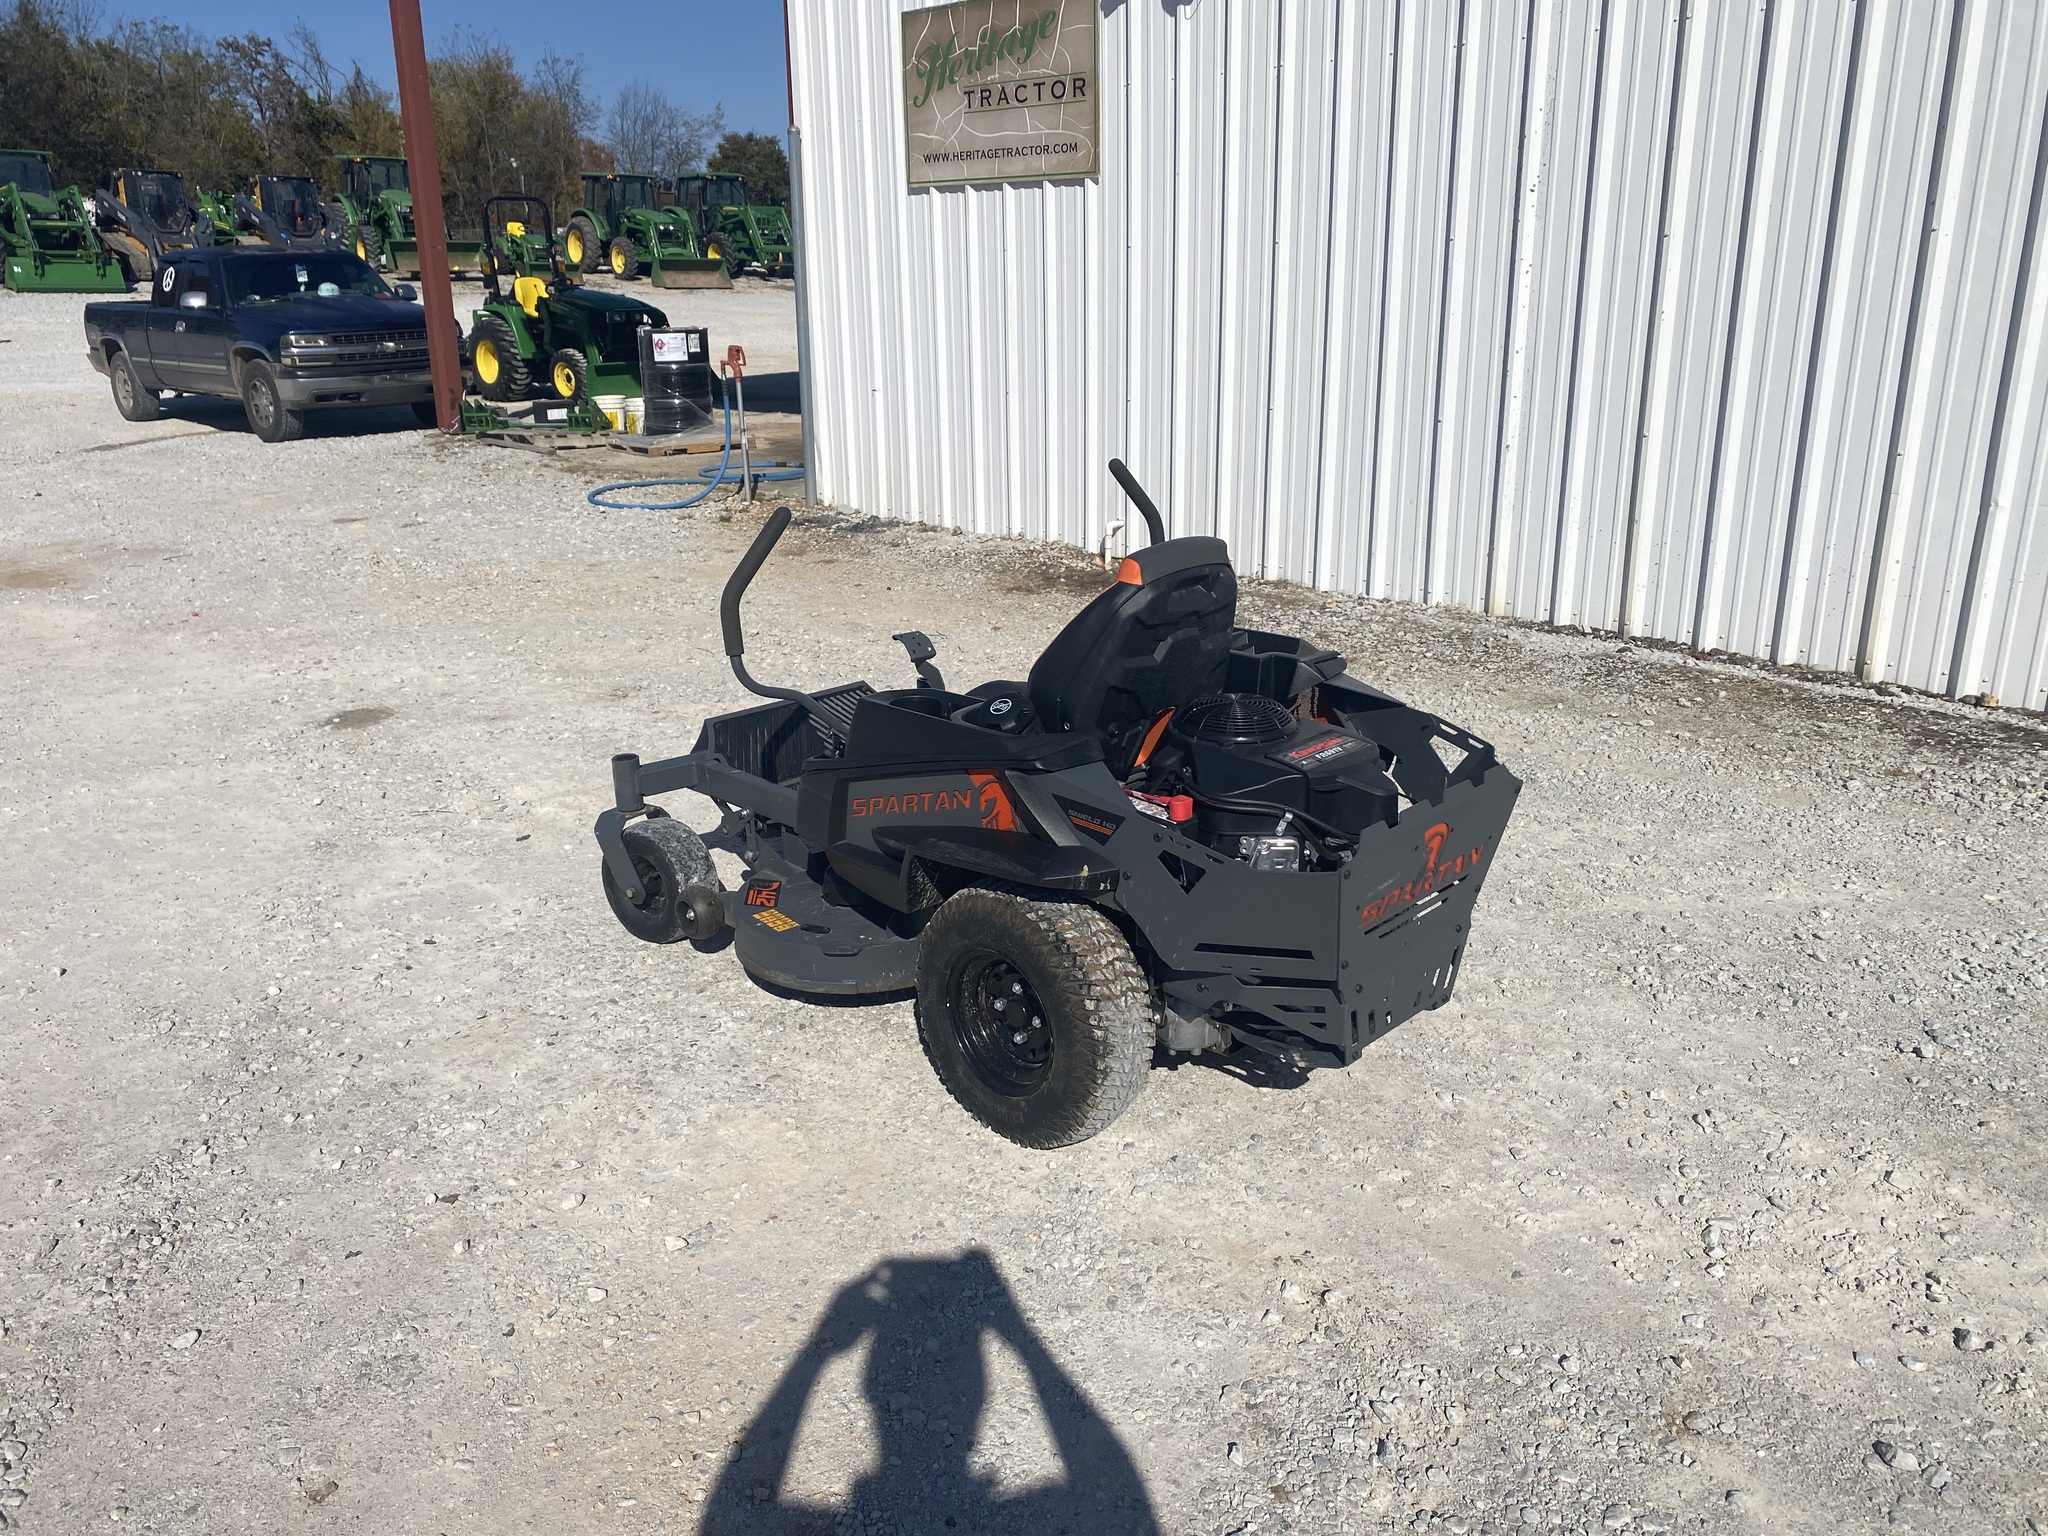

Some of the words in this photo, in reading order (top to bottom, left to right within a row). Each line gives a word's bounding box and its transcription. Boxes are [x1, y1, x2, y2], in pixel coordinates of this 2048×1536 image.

[913, 9, 1057, 108] Heritage
[963, 77, 1087, 109] TRACTOR
[923, 142, 1078, 164] WWW.HERITAGETRACTOR.COM
[852, 788, 972, 818] SPARTAN
[1068, 809, 1101, 825] SHIELD
[1357, 843, 1486, 929] SPARTAN
